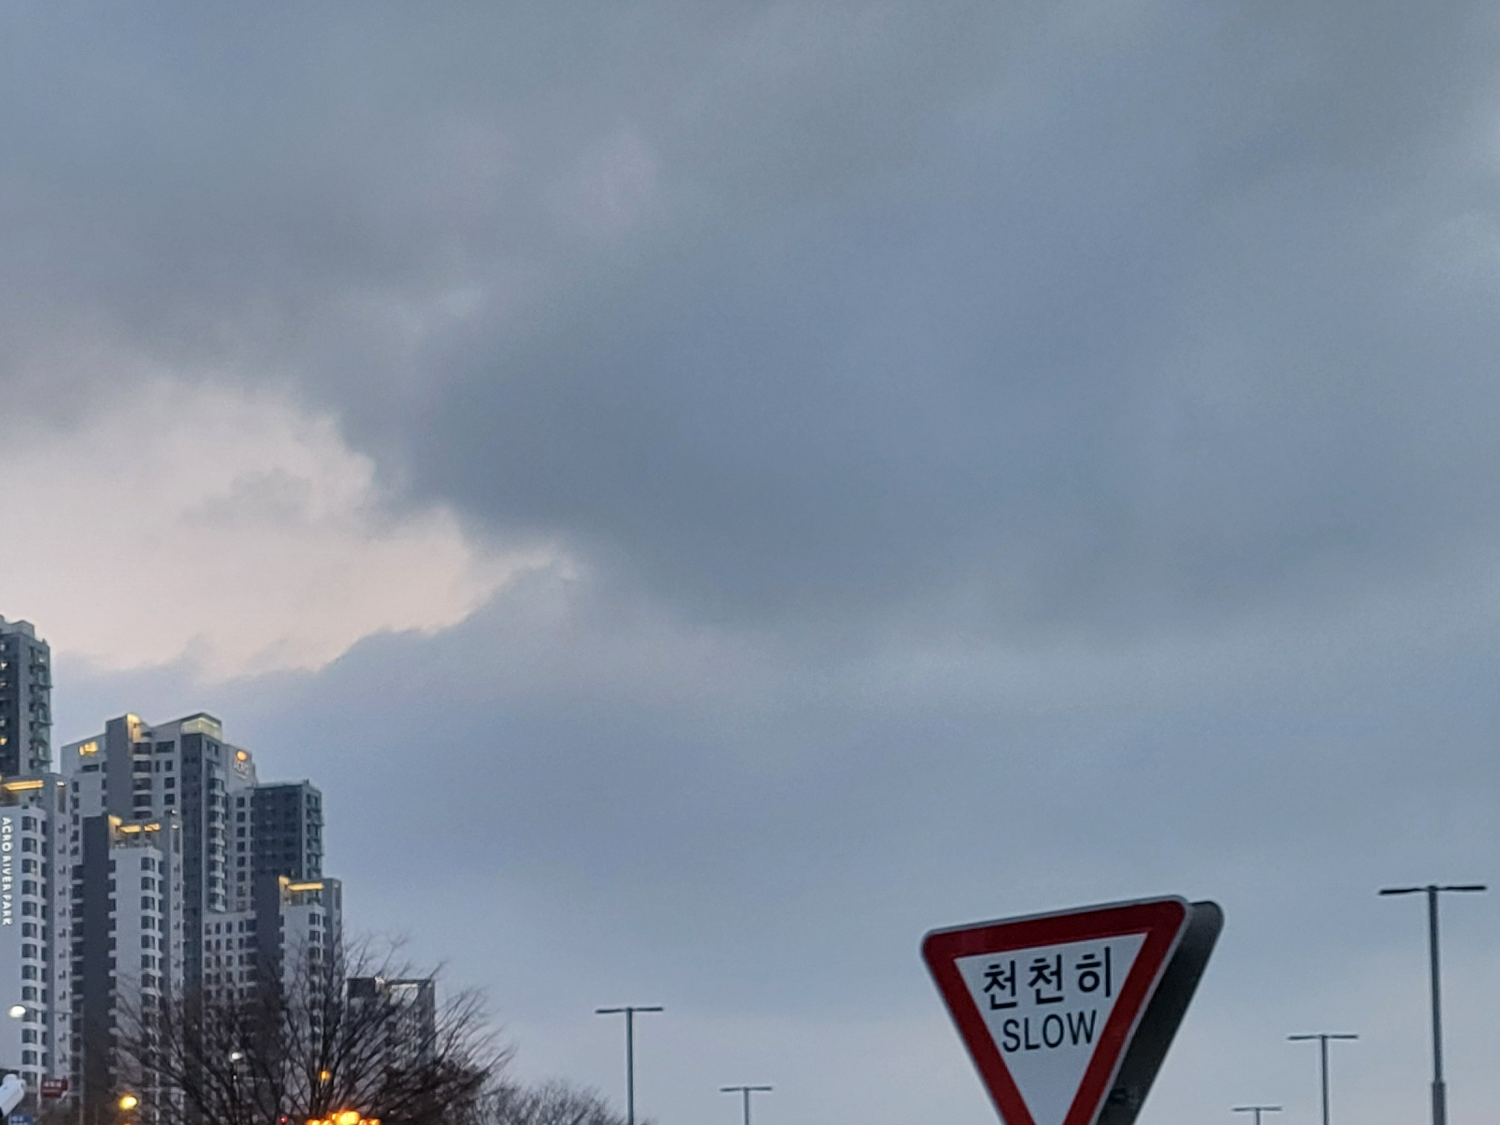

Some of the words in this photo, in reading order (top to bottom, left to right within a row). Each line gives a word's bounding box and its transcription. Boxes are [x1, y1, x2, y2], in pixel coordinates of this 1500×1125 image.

[1, 816, 13, 852] ACRO
[1, 855, 13, 891] RIVER
[2, 894, 13, 925] PARK
[983, 946, 1113, 1011] 천천히
[1002, 1009, 1097, 1053] SLOW
